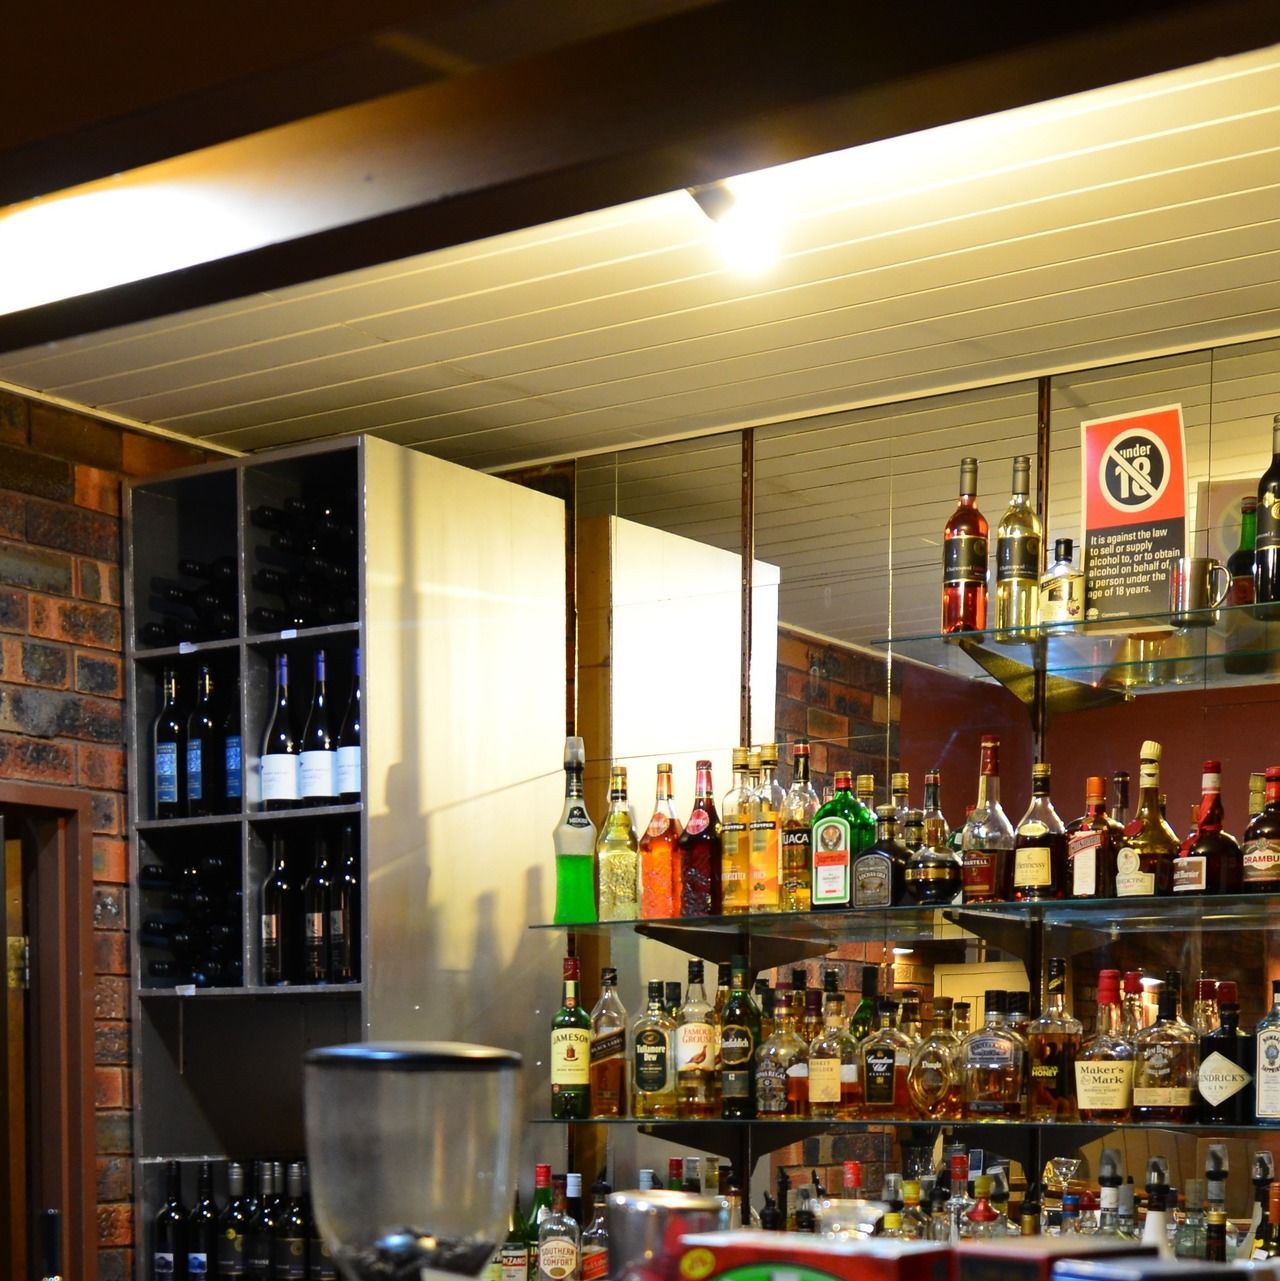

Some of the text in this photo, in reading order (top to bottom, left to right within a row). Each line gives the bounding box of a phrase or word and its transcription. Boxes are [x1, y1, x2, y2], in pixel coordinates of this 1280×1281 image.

[1119, 443, 1151, 459] under
[1114, 456, 1152, 499] 18
[1090, 527, 1168, 546] It is against the law
[1090, 540, 1153, 556] to sell or supply
[1089, 547, 1181, 567] alcohol to, or to obtain
[1089, 559, 1170, 577] alcohol on behalf of
[1088, 571, 1166, 589] a person under the
[1088, 585, 1152, 600] age of 18 years.
[552, 1033, 589, 1045] JAMESON
[636, 1045, 666, 1054] Tullamore
[643, 1053, 658, 1062] Dew
[1080, 1065, 1125, 1074] Maker's
[1091, 1074, 1125, 1084] Mark
[541, 1247, 574, 1256] SOUTHERN
[543, 1258, 573, 1266] COMFORT
